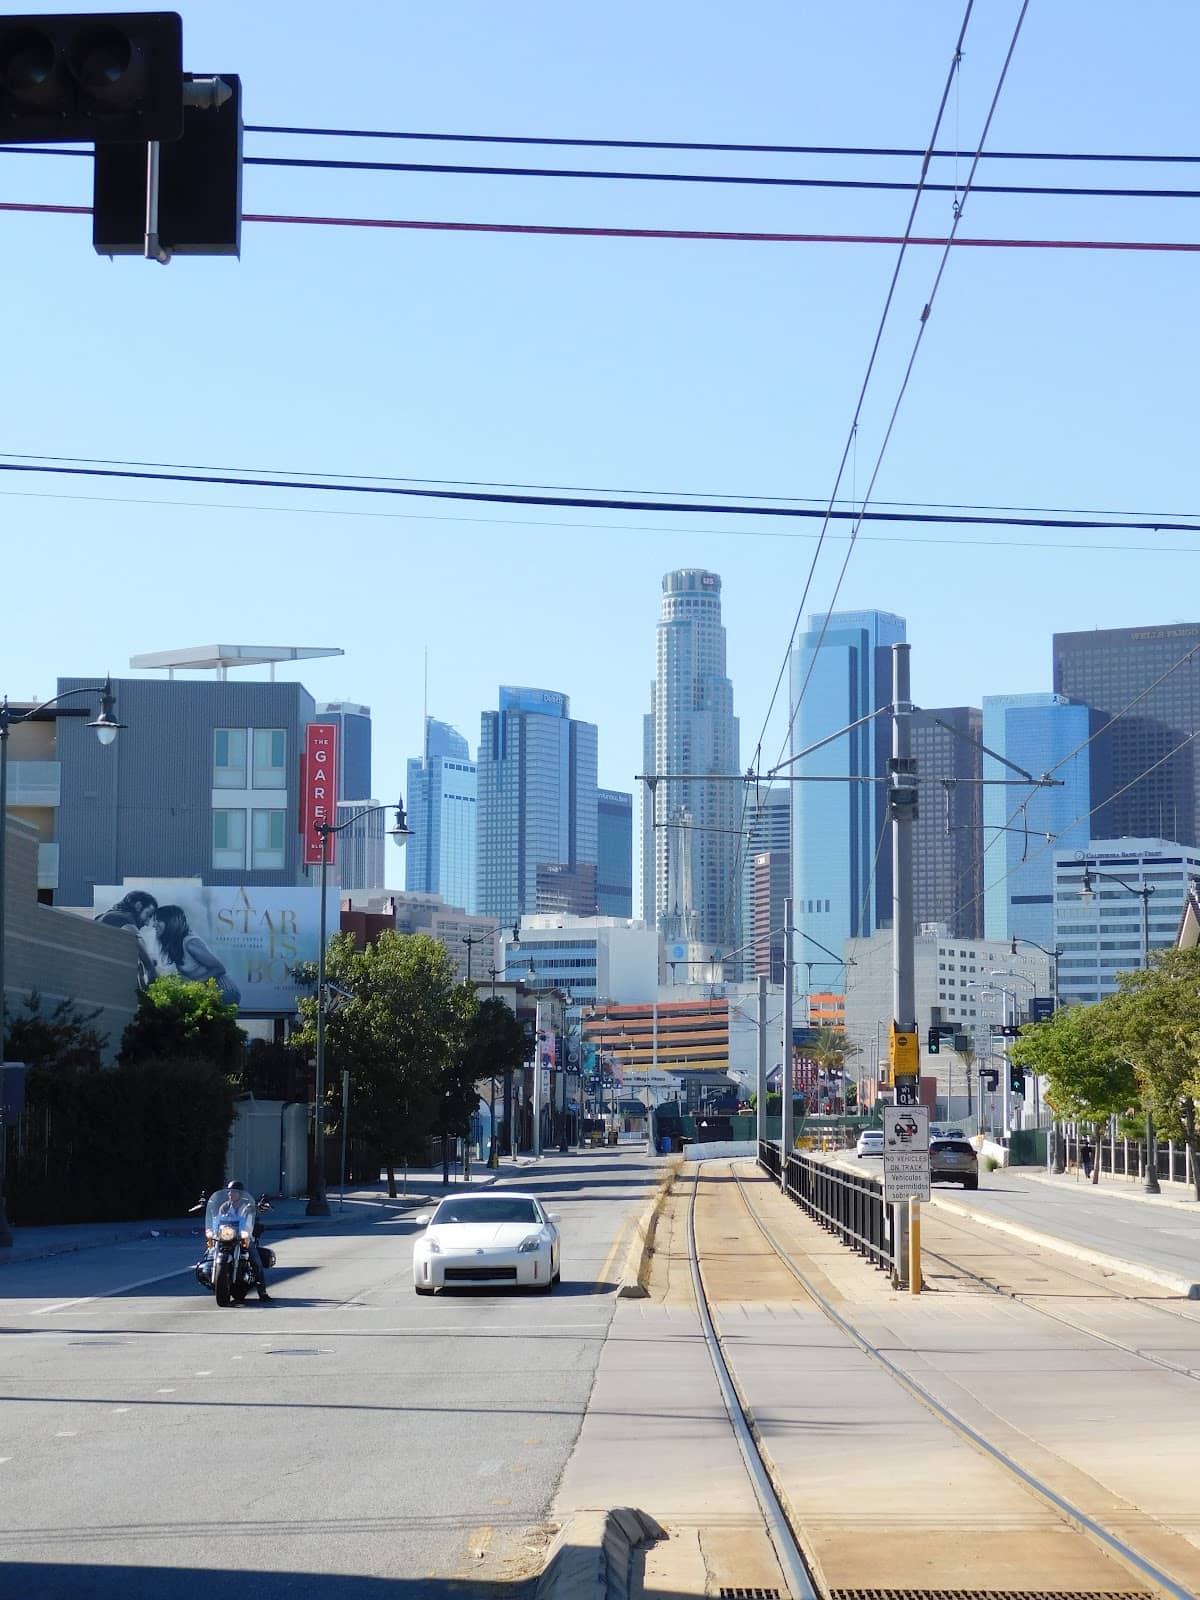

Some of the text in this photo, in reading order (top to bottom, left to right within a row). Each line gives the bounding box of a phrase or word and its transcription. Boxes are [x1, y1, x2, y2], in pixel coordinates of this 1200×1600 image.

[314, 750, 327, 841] GARE
[233, 885, 250, 910] A
[217, 908, 298, 935] STAR
[268, 932, 298, 960] IS
